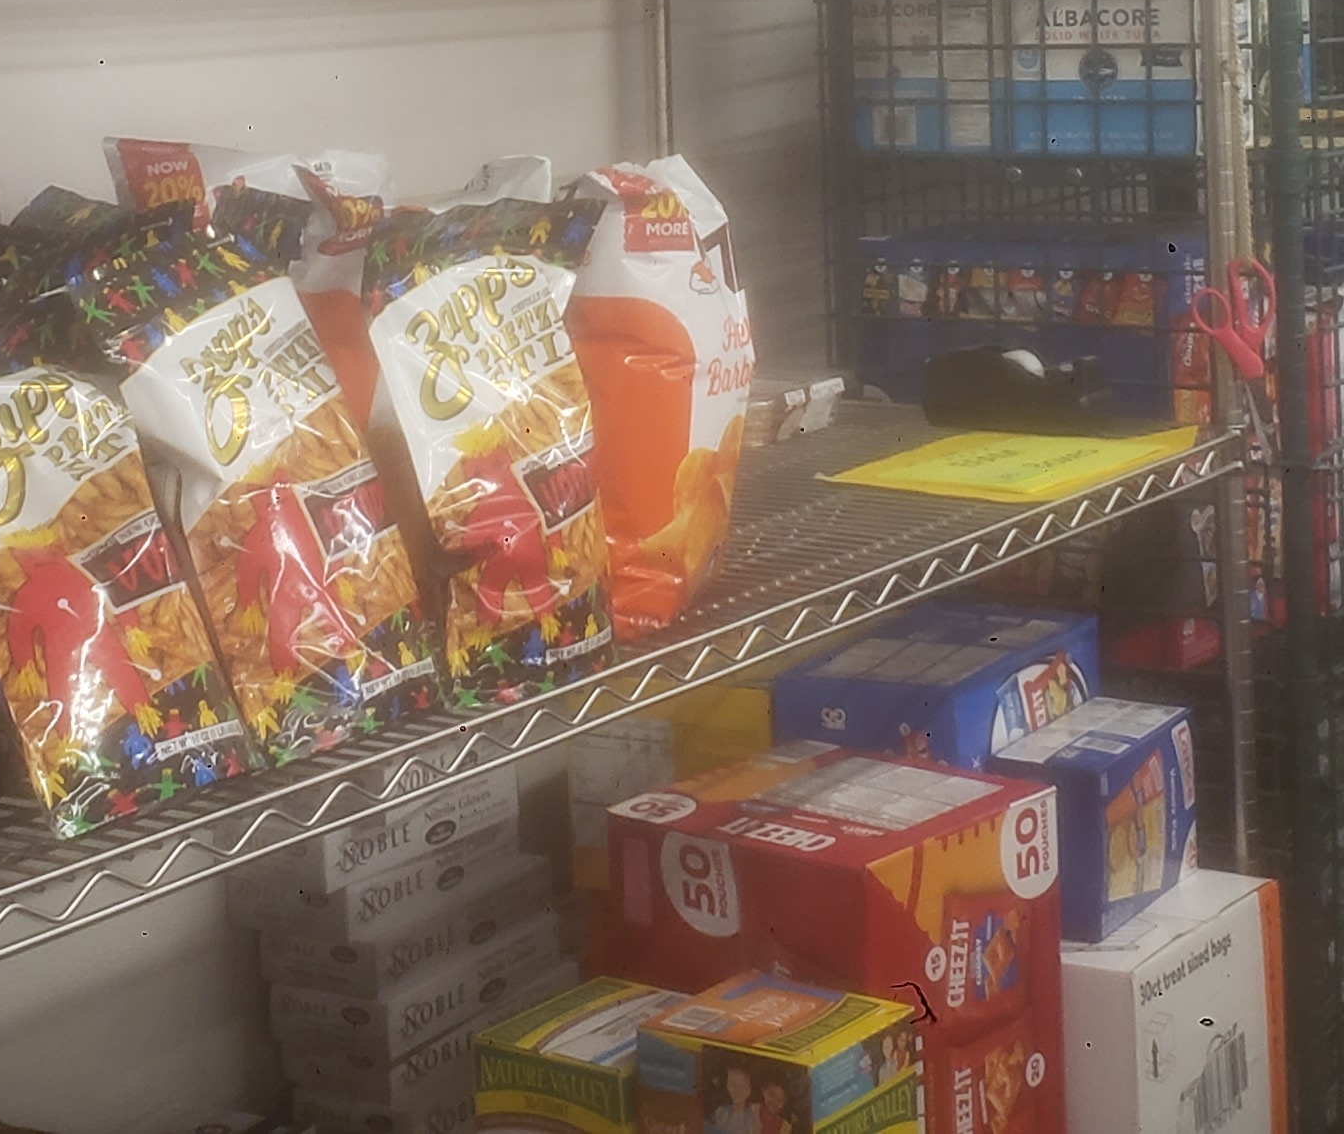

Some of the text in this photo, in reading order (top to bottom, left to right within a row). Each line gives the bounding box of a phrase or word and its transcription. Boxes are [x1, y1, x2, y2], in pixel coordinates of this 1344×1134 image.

[1035, 8, 1161, 27] ALBACORE
[1079, 29, 1120, 40] WITE
[1126, 29, 1161, 40] TUA
[143, 174, 203, 209] 20%
[146, 160, 189, 178] NOW
[646, 222, 689, 236] MORE
[406, 259, 537, 421] Zapp's
[336, 823, 411, 874] NOBLE
[1015, 800, 1051, 880] 50 POUCHES
[357, 868, 424, 922] NOBLE
[678, 844, 729, 919] 50 POUCHES
[388, 924, 456, 979] NOBLE
[931, 953, 941, 975] 15
[400, 980, 466, 1039] NOBLE
[480, 1053, 544, 1088] NATURE
[549, 1064, 613, 1112] VALLEY
[867, 1080, 914, 1124] VALLEY
